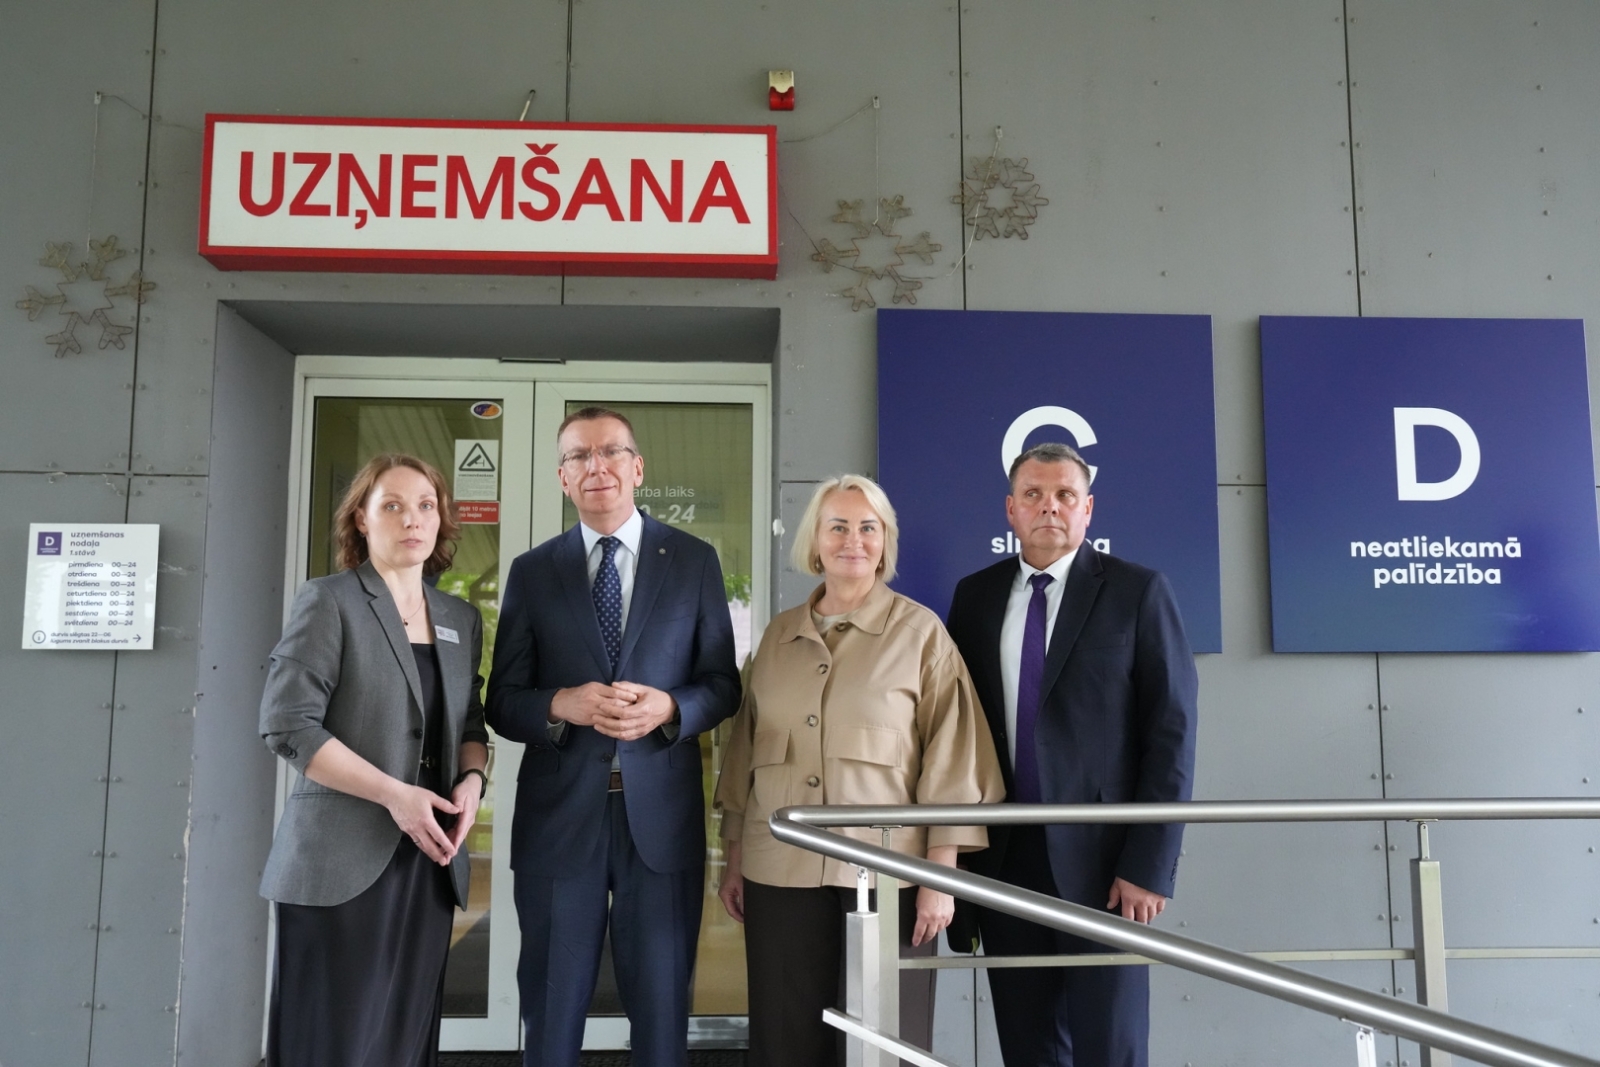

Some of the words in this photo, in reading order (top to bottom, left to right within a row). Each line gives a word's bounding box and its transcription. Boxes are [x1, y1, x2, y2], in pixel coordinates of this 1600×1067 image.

[238, 142, 751, 230] UZŅEMŠANA
[1001, 405, 1098, 487] C
[1393, 407, 1481, 501] D
[633, 485, 661, 498] arba
[665, 485, 695, 498] laiks
[45, 536, 55, 546] D
[70, 540, 100, 548] nodaļa
[71, 531, 125, 540] uzņemšanas
[1350, 535, 1522, 558] neatliekamā
[1373, 562, 1502, 589] palīdzība
